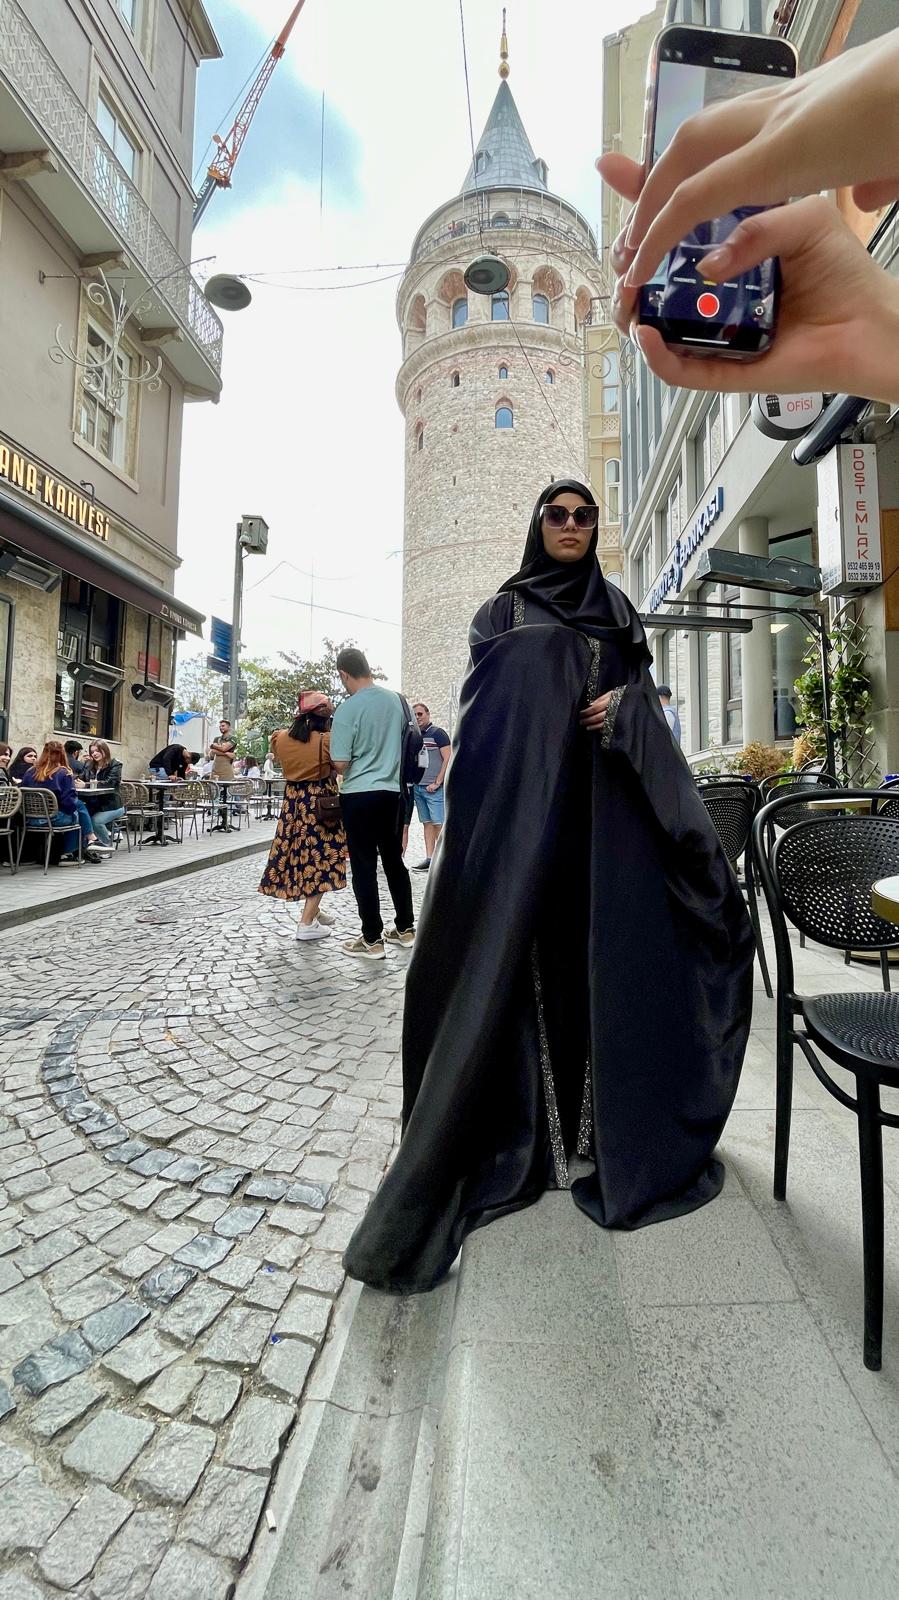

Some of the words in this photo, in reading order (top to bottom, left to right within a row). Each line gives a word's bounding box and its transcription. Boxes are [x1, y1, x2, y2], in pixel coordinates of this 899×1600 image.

[853, 448, 866, 495] DOST
[44, 475, 110, 541] KAHVESİ
[855, 500, 869, 560] EMLAK
